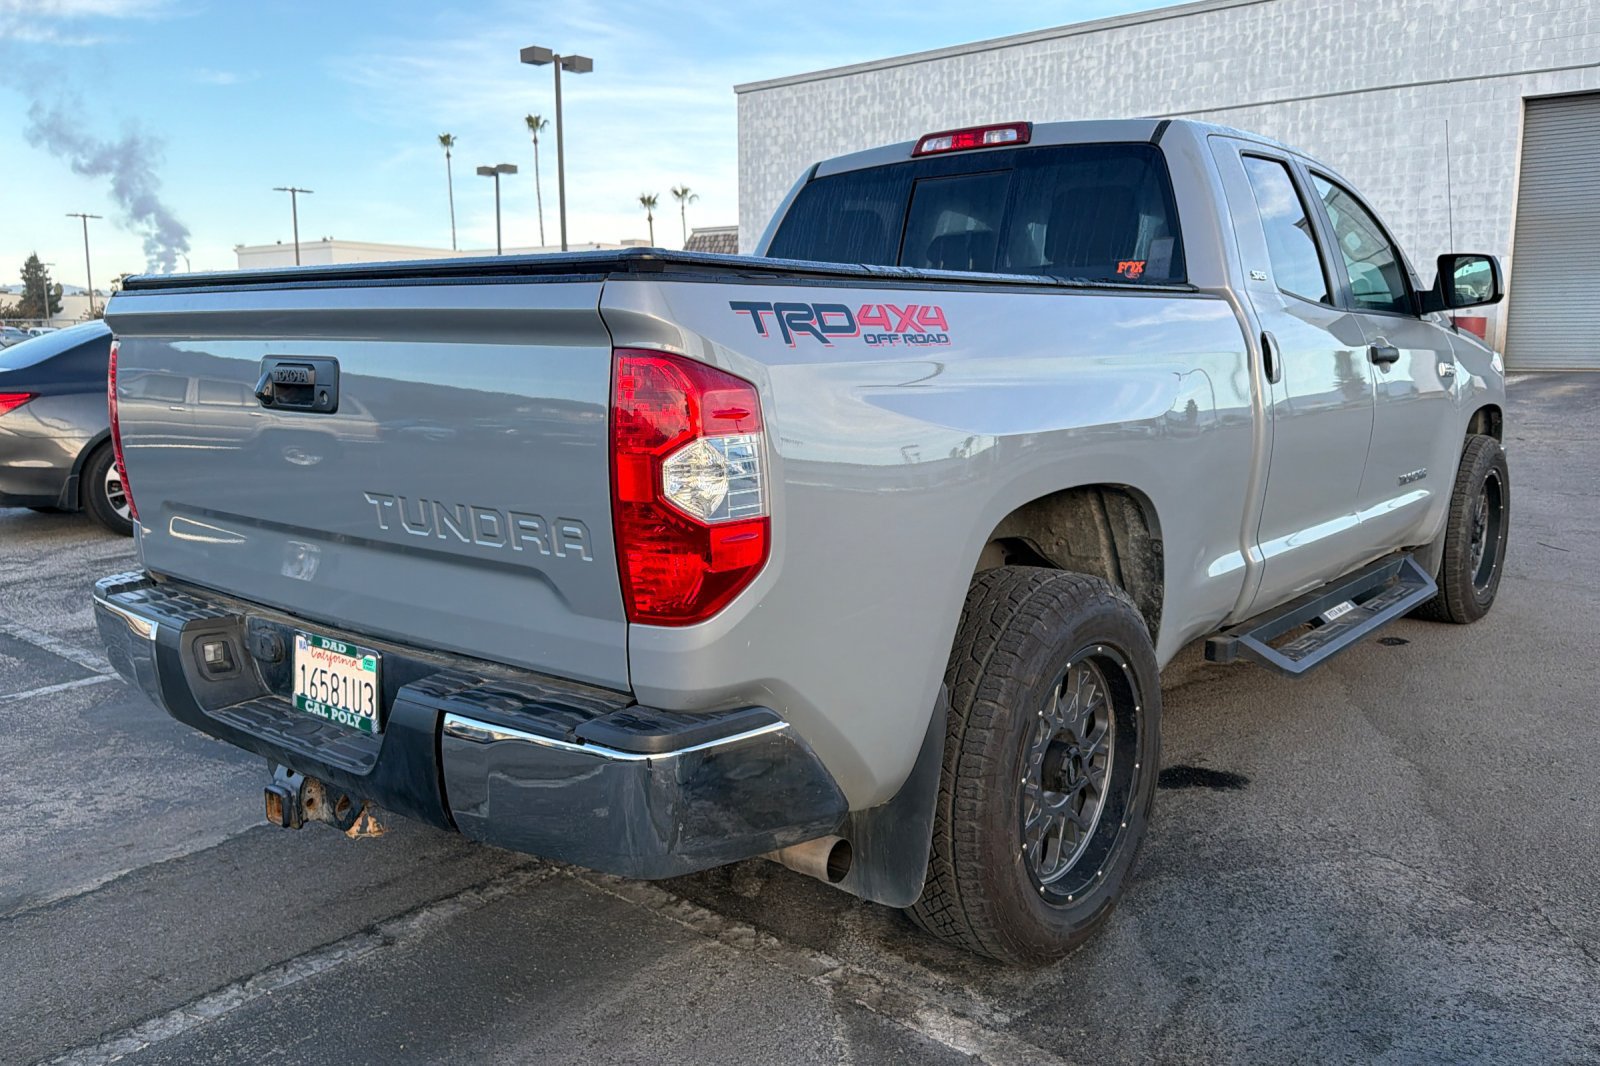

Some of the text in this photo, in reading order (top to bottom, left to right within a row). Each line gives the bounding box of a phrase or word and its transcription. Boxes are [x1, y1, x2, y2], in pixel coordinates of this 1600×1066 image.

[1117, 261, 1145, 278] FOX
[729, 301, 949, 347] TRD 4X4
[864, 334, 950, 346] OFF ROAD
[274, 369, 308, 383] TOYOTA
[364, 491, 593, 562] TUNDRA
[321, 639, 347, 653] DAD
[311, 647, 363, 671] California
[300, 664, 374, 717] 16581U3
[305, 700, 362, 728] CAL POLY
